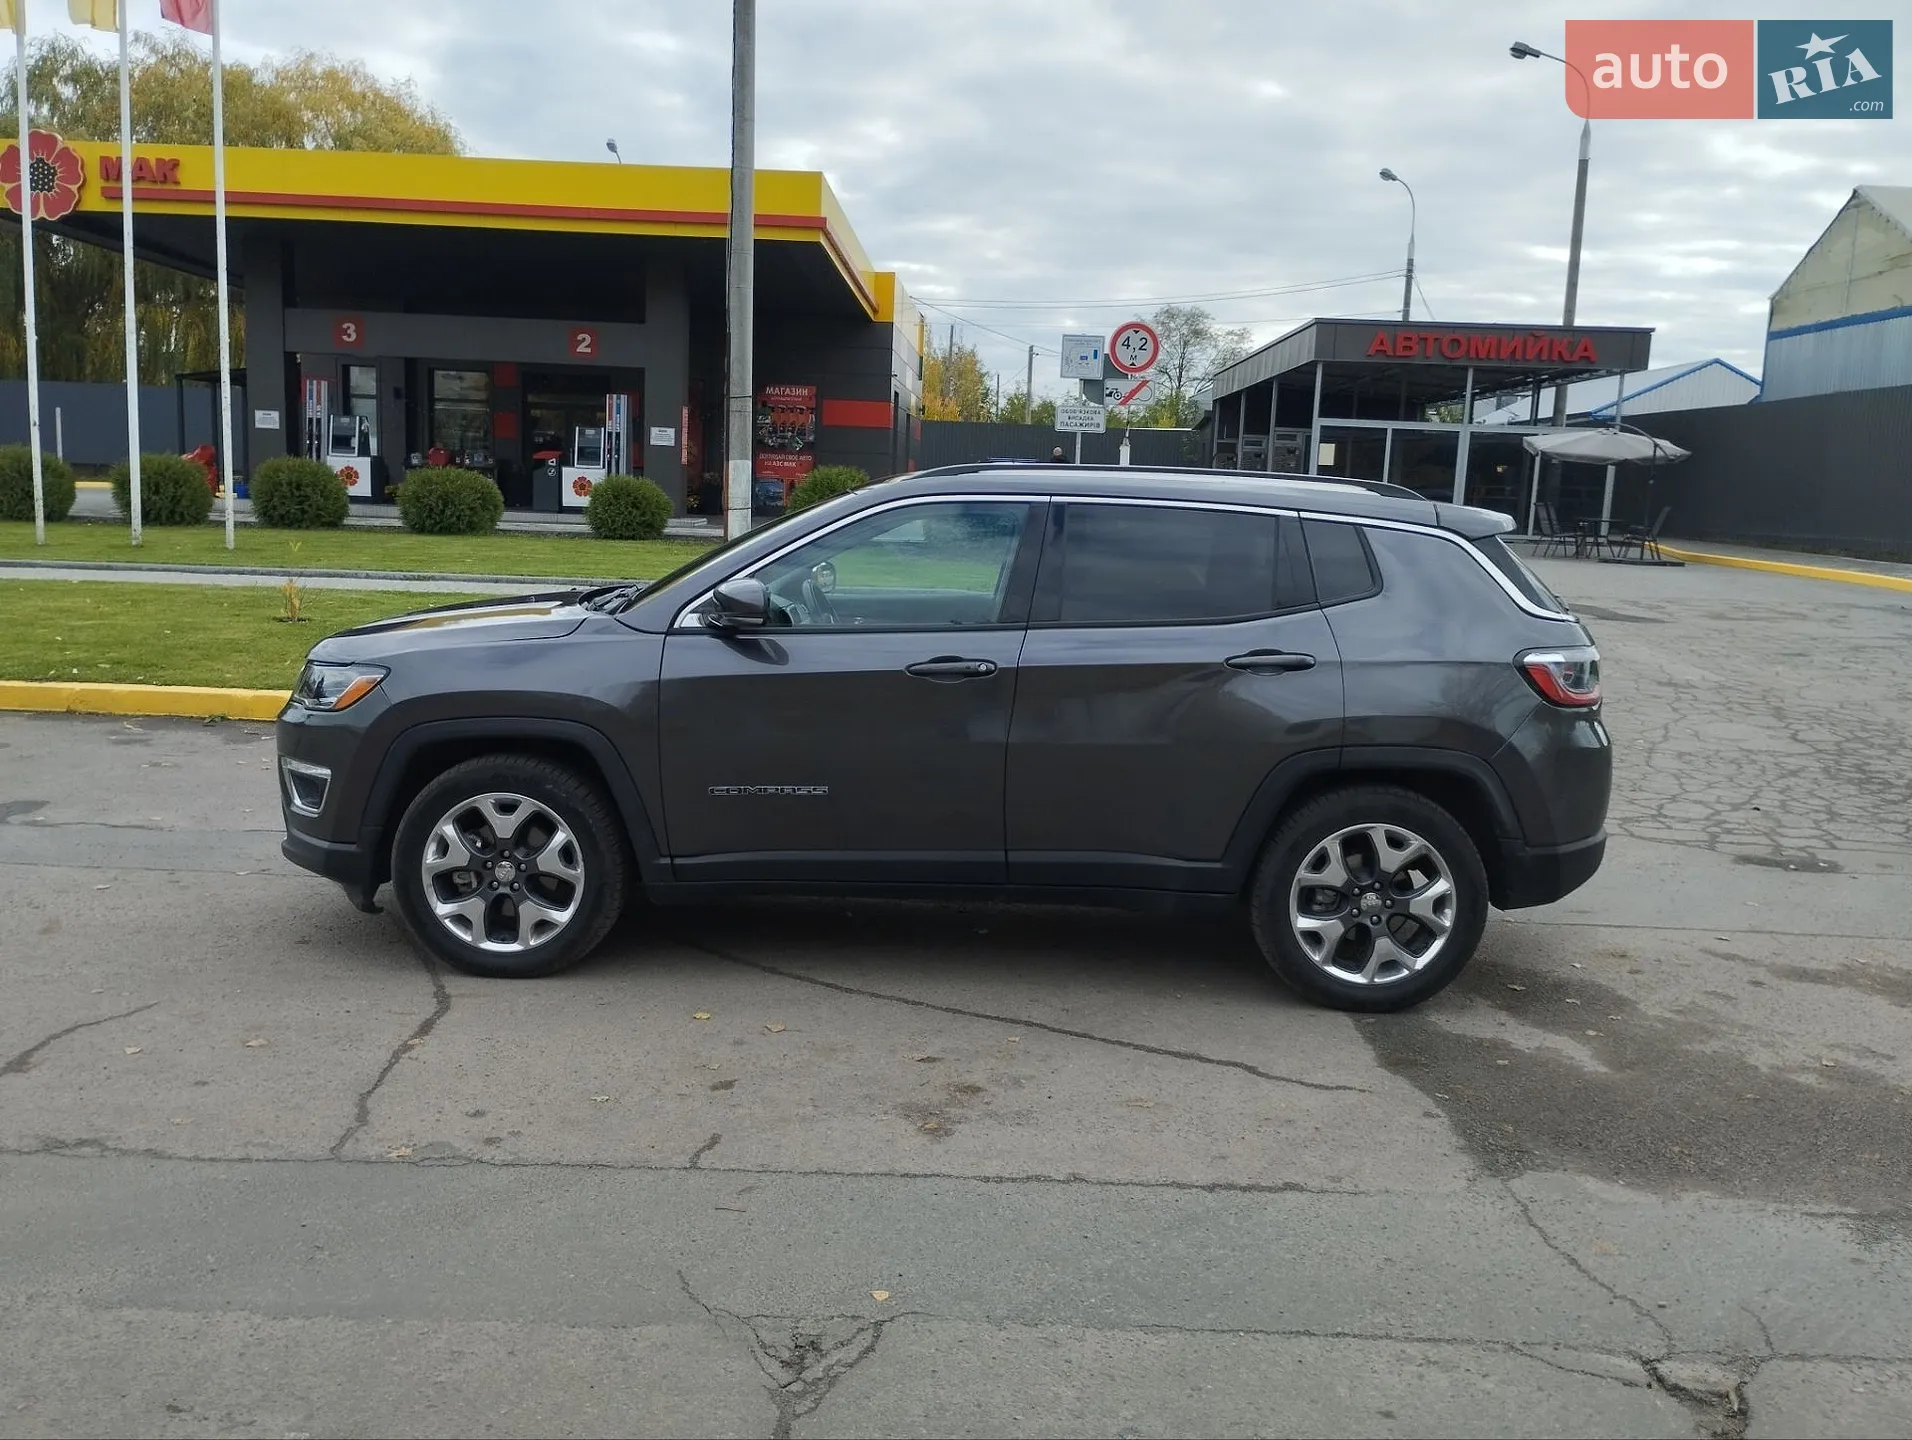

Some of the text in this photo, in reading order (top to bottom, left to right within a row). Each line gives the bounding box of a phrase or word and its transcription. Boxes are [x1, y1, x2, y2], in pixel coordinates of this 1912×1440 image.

[99, 155, 181, 185] МАК
[342, 322, 357, 342] 3
[576, 333, 592, 353] 2
[1121, 336, 1148, 352] 4,2
[1366, 329, 1598, 363] АВТОМИЙКА
[765, 386, 808, 396] МАГАЗИН
[1059, 421, 1101, 429] ПАСАЖИРІВ
[708, 785, 829, 796] COMPASS
